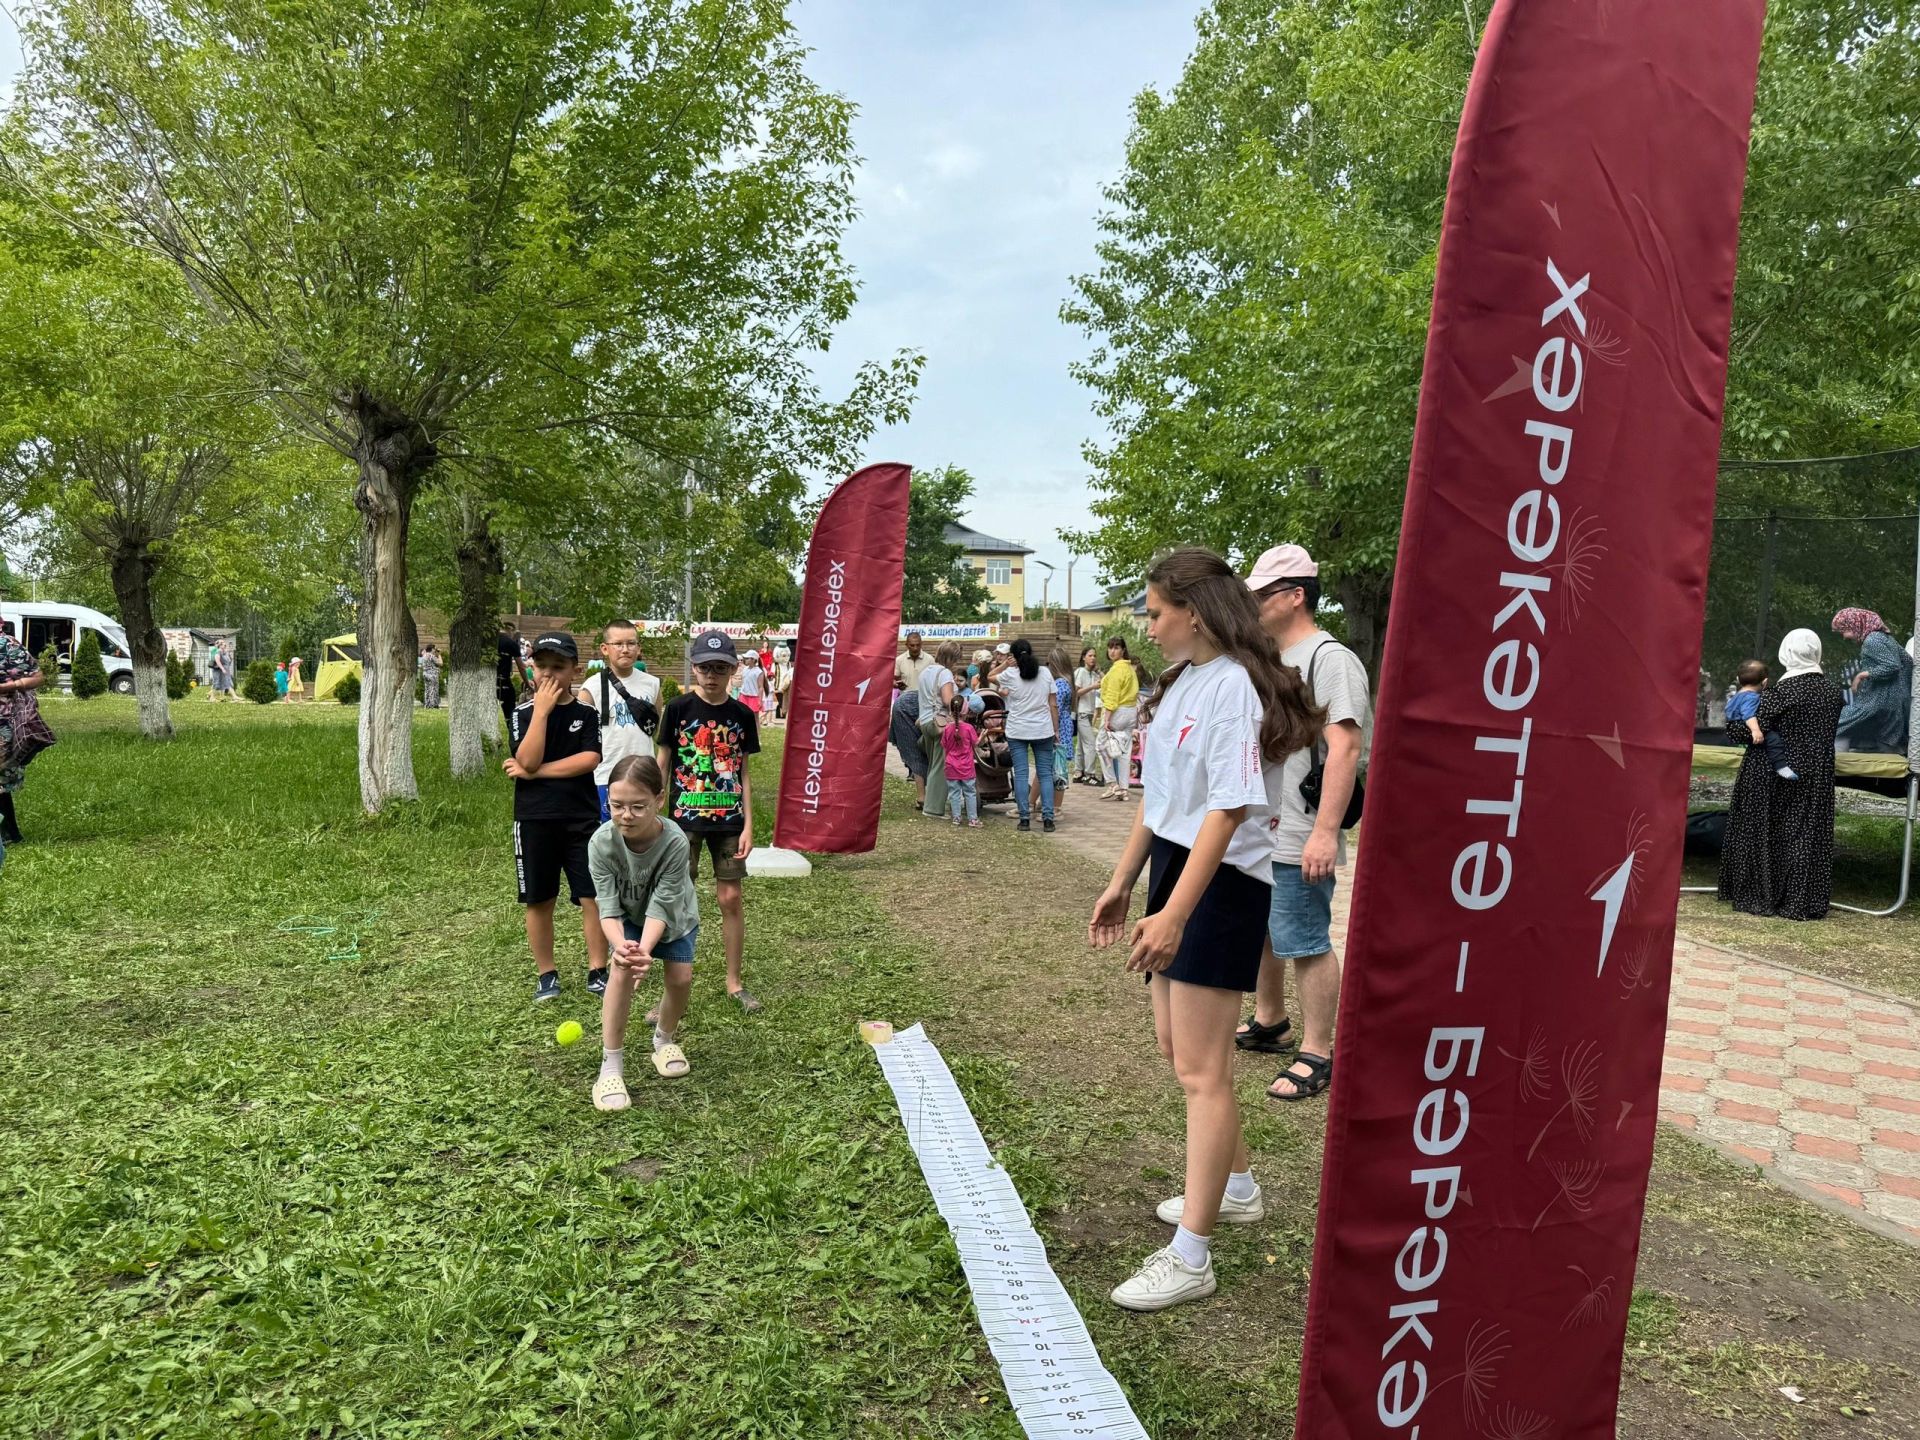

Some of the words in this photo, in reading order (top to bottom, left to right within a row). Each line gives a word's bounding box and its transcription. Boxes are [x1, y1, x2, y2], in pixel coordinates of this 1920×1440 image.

[816, 559, 846, 688] ХӘРӘКӘТТӘ
[928, 628, 962, 637] ЗАЩИТЫ
[963, 626, 986, 637] ДЕТЕЙ
[1451, 256, 1591, 912] ХӘРӘКӘТТӘ
[802, 709, 829, 814] БӘРӘКӘТ!
[1375, 1026, 1486, 1440] БӘРӘКӘ
[1067, 1411, 1086, 1420] 35
